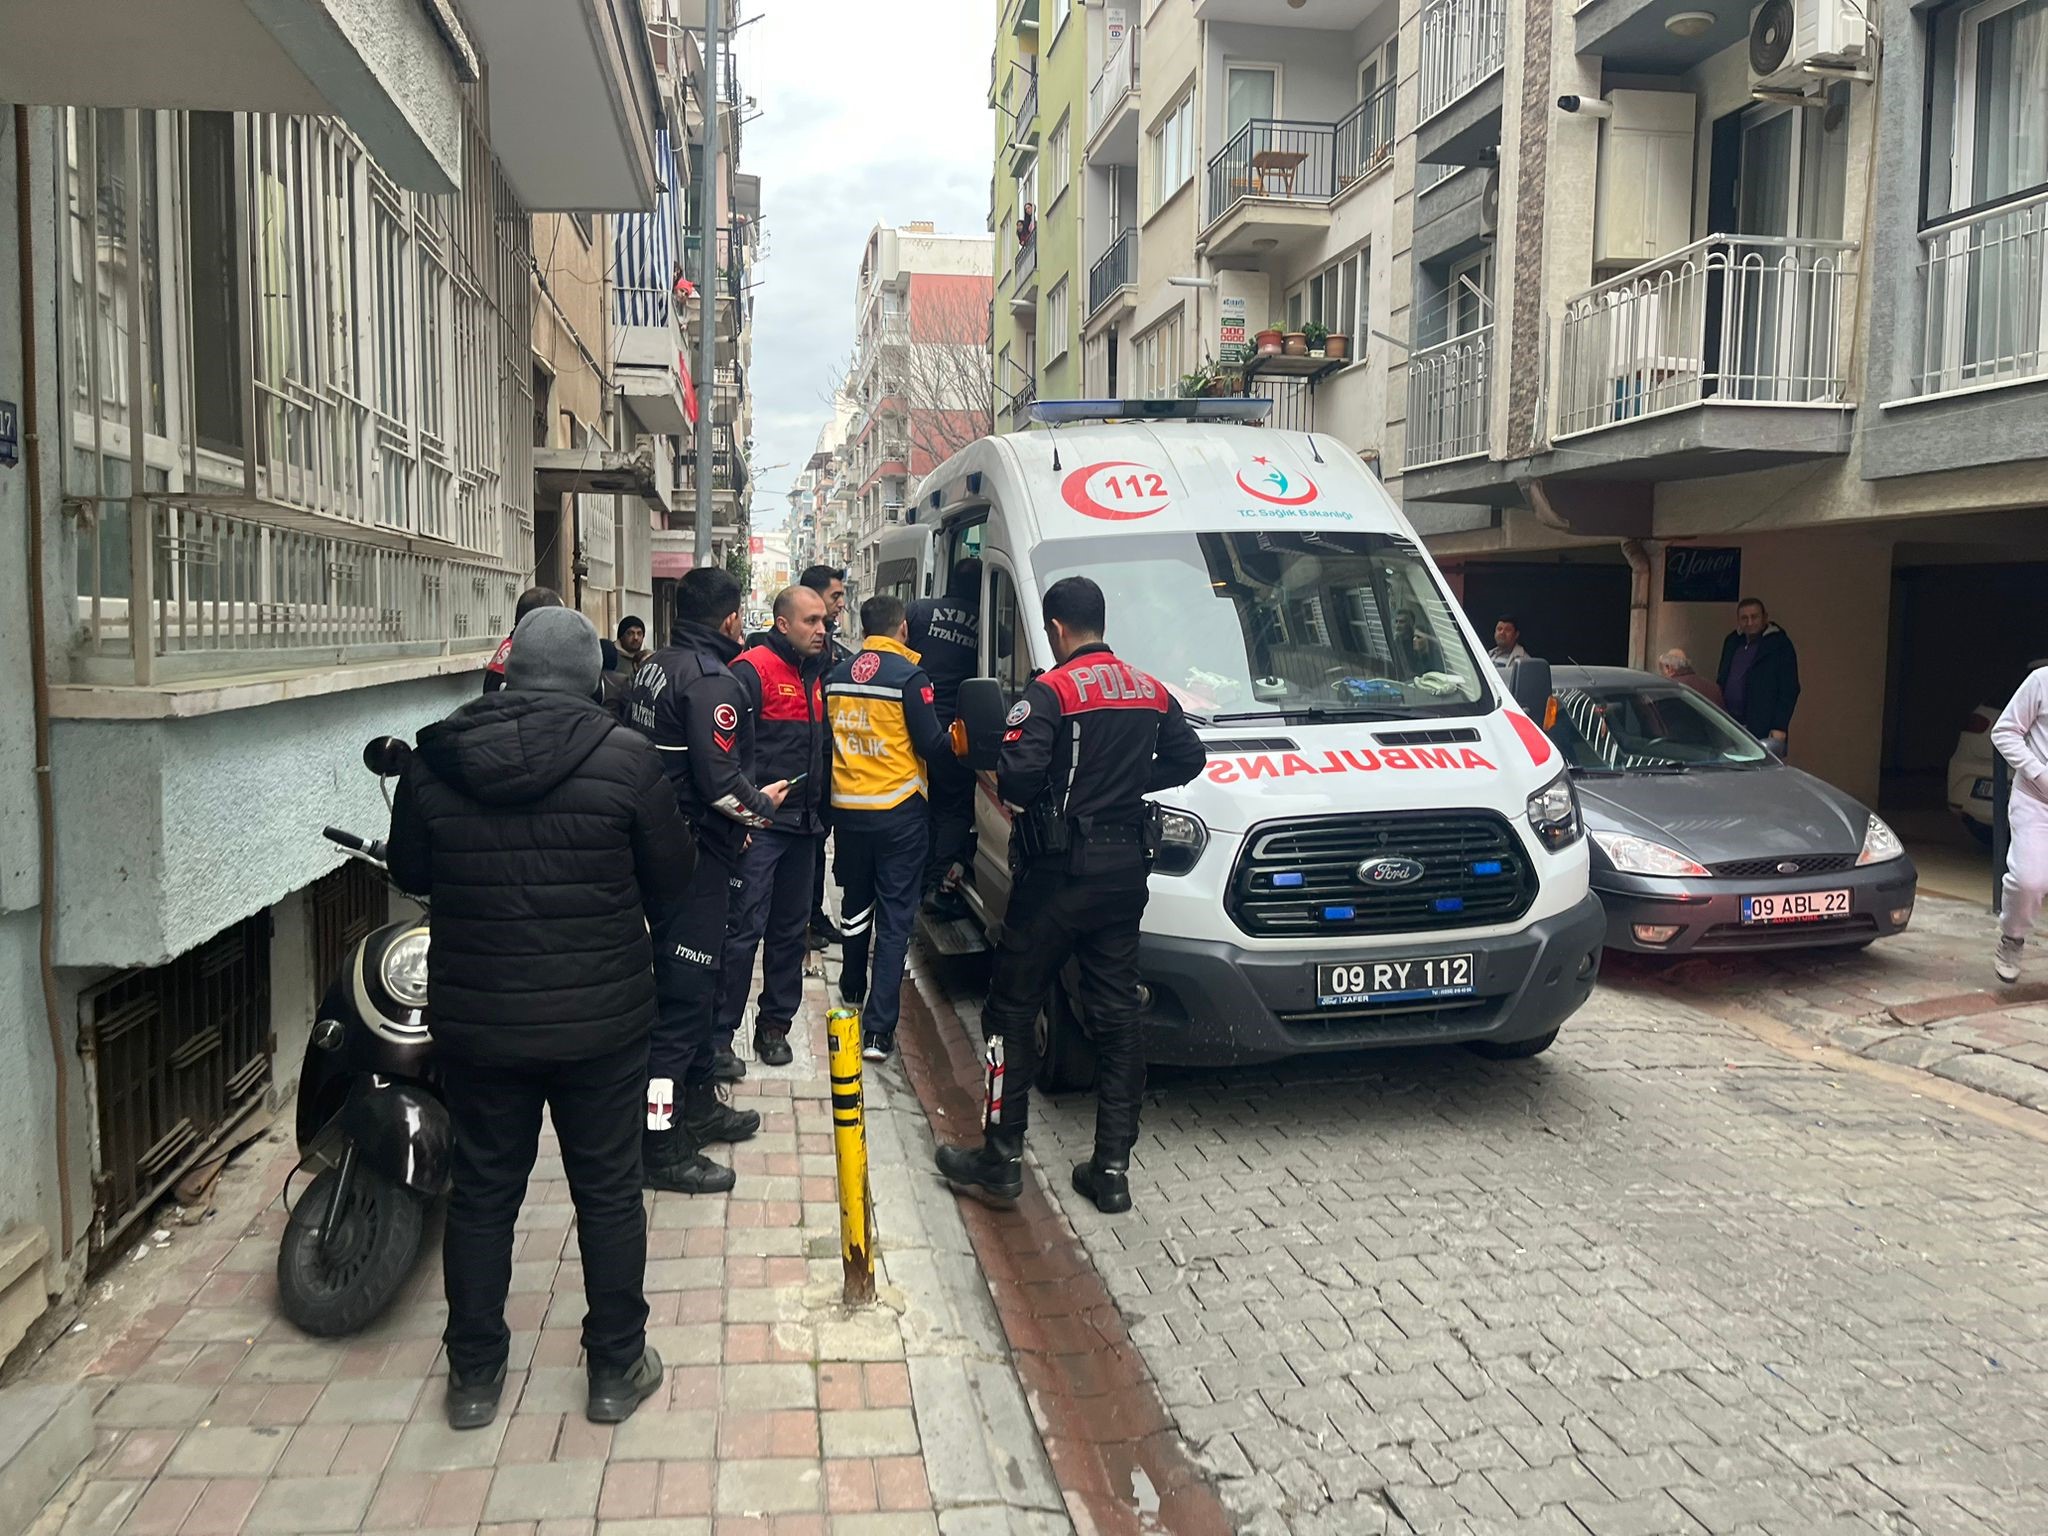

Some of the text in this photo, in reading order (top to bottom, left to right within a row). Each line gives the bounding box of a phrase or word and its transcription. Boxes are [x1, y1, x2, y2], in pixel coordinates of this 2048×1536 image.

[1104, 473, 1168, 499] 112
[1259, 509, 1297, 518] Sağlık
[1299, 509, 1354, 520] Bakanlığı
[835, 732, 889, 756] AĞLIK
[1374, 862, 1410, 880] Ford
[1752, 893, 1846, 916] 09 ABL 22
[675, 944, 713, 965] İTFAİYE
[1332, 958, 1468, 994] 09 RY 112
[1342, 995, 1369, 1004] ZAFER
